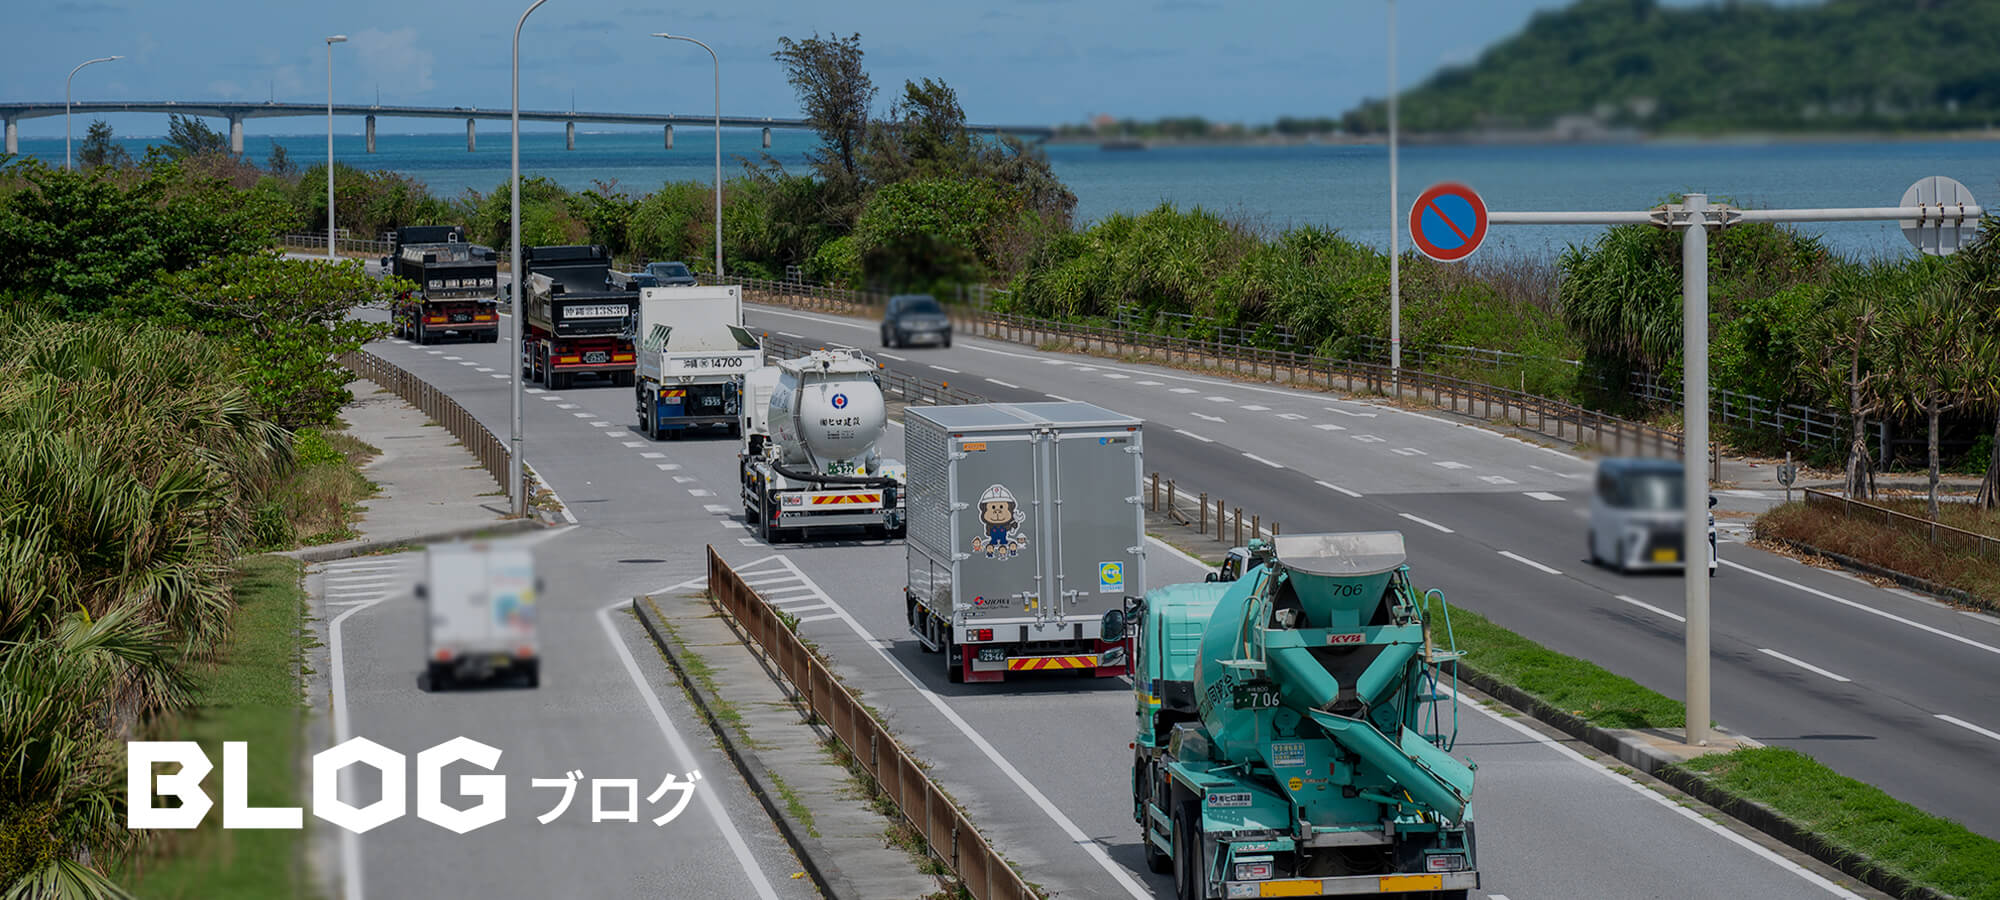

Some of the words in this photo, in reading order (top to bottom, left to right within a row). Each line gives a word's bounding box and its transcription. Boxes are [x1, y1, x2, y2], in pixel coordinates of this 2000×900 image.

[711, 357, 743, 368] 14700
[1332, 583, 1363, 597] 706
[1330, 634, 1361, 644] KYB
